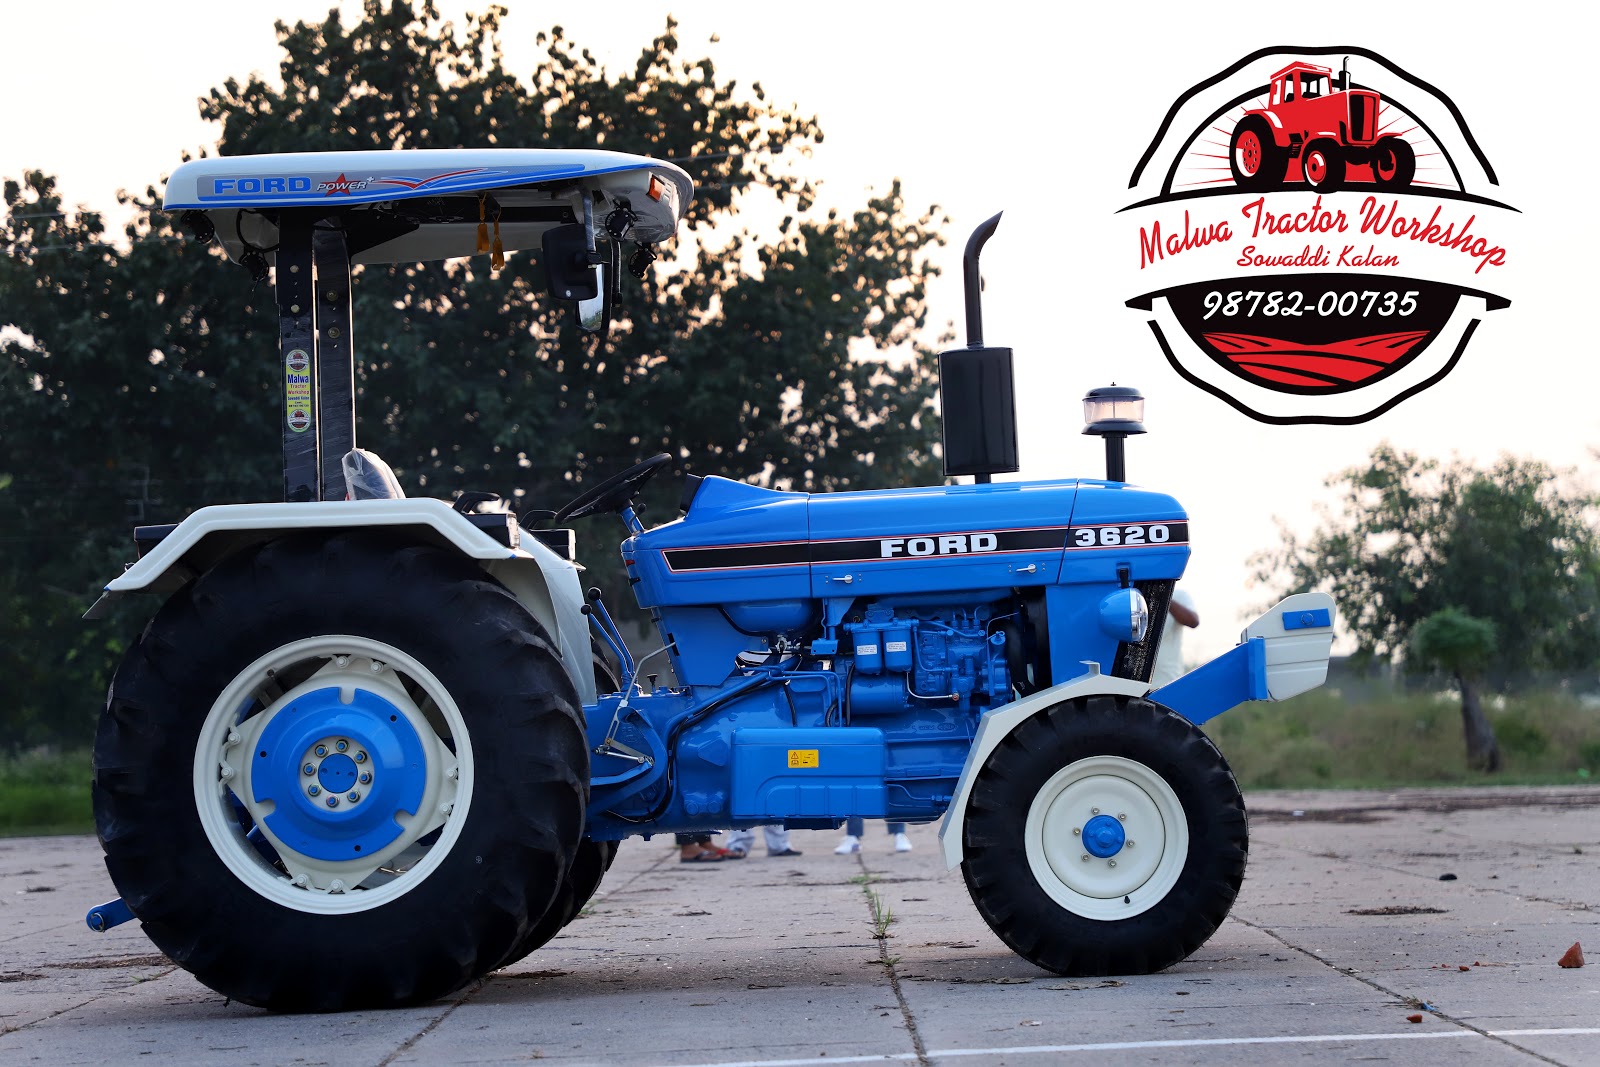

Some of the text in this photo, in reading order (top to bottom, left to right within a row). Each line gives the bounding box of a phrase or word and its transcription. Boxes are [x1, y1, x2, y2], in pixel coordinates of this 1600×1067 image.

[213, 176, 312, 195] FORD
[287, 374, 309, 383] Malwa
[880, 524, 1170, 558] FORD 3620
